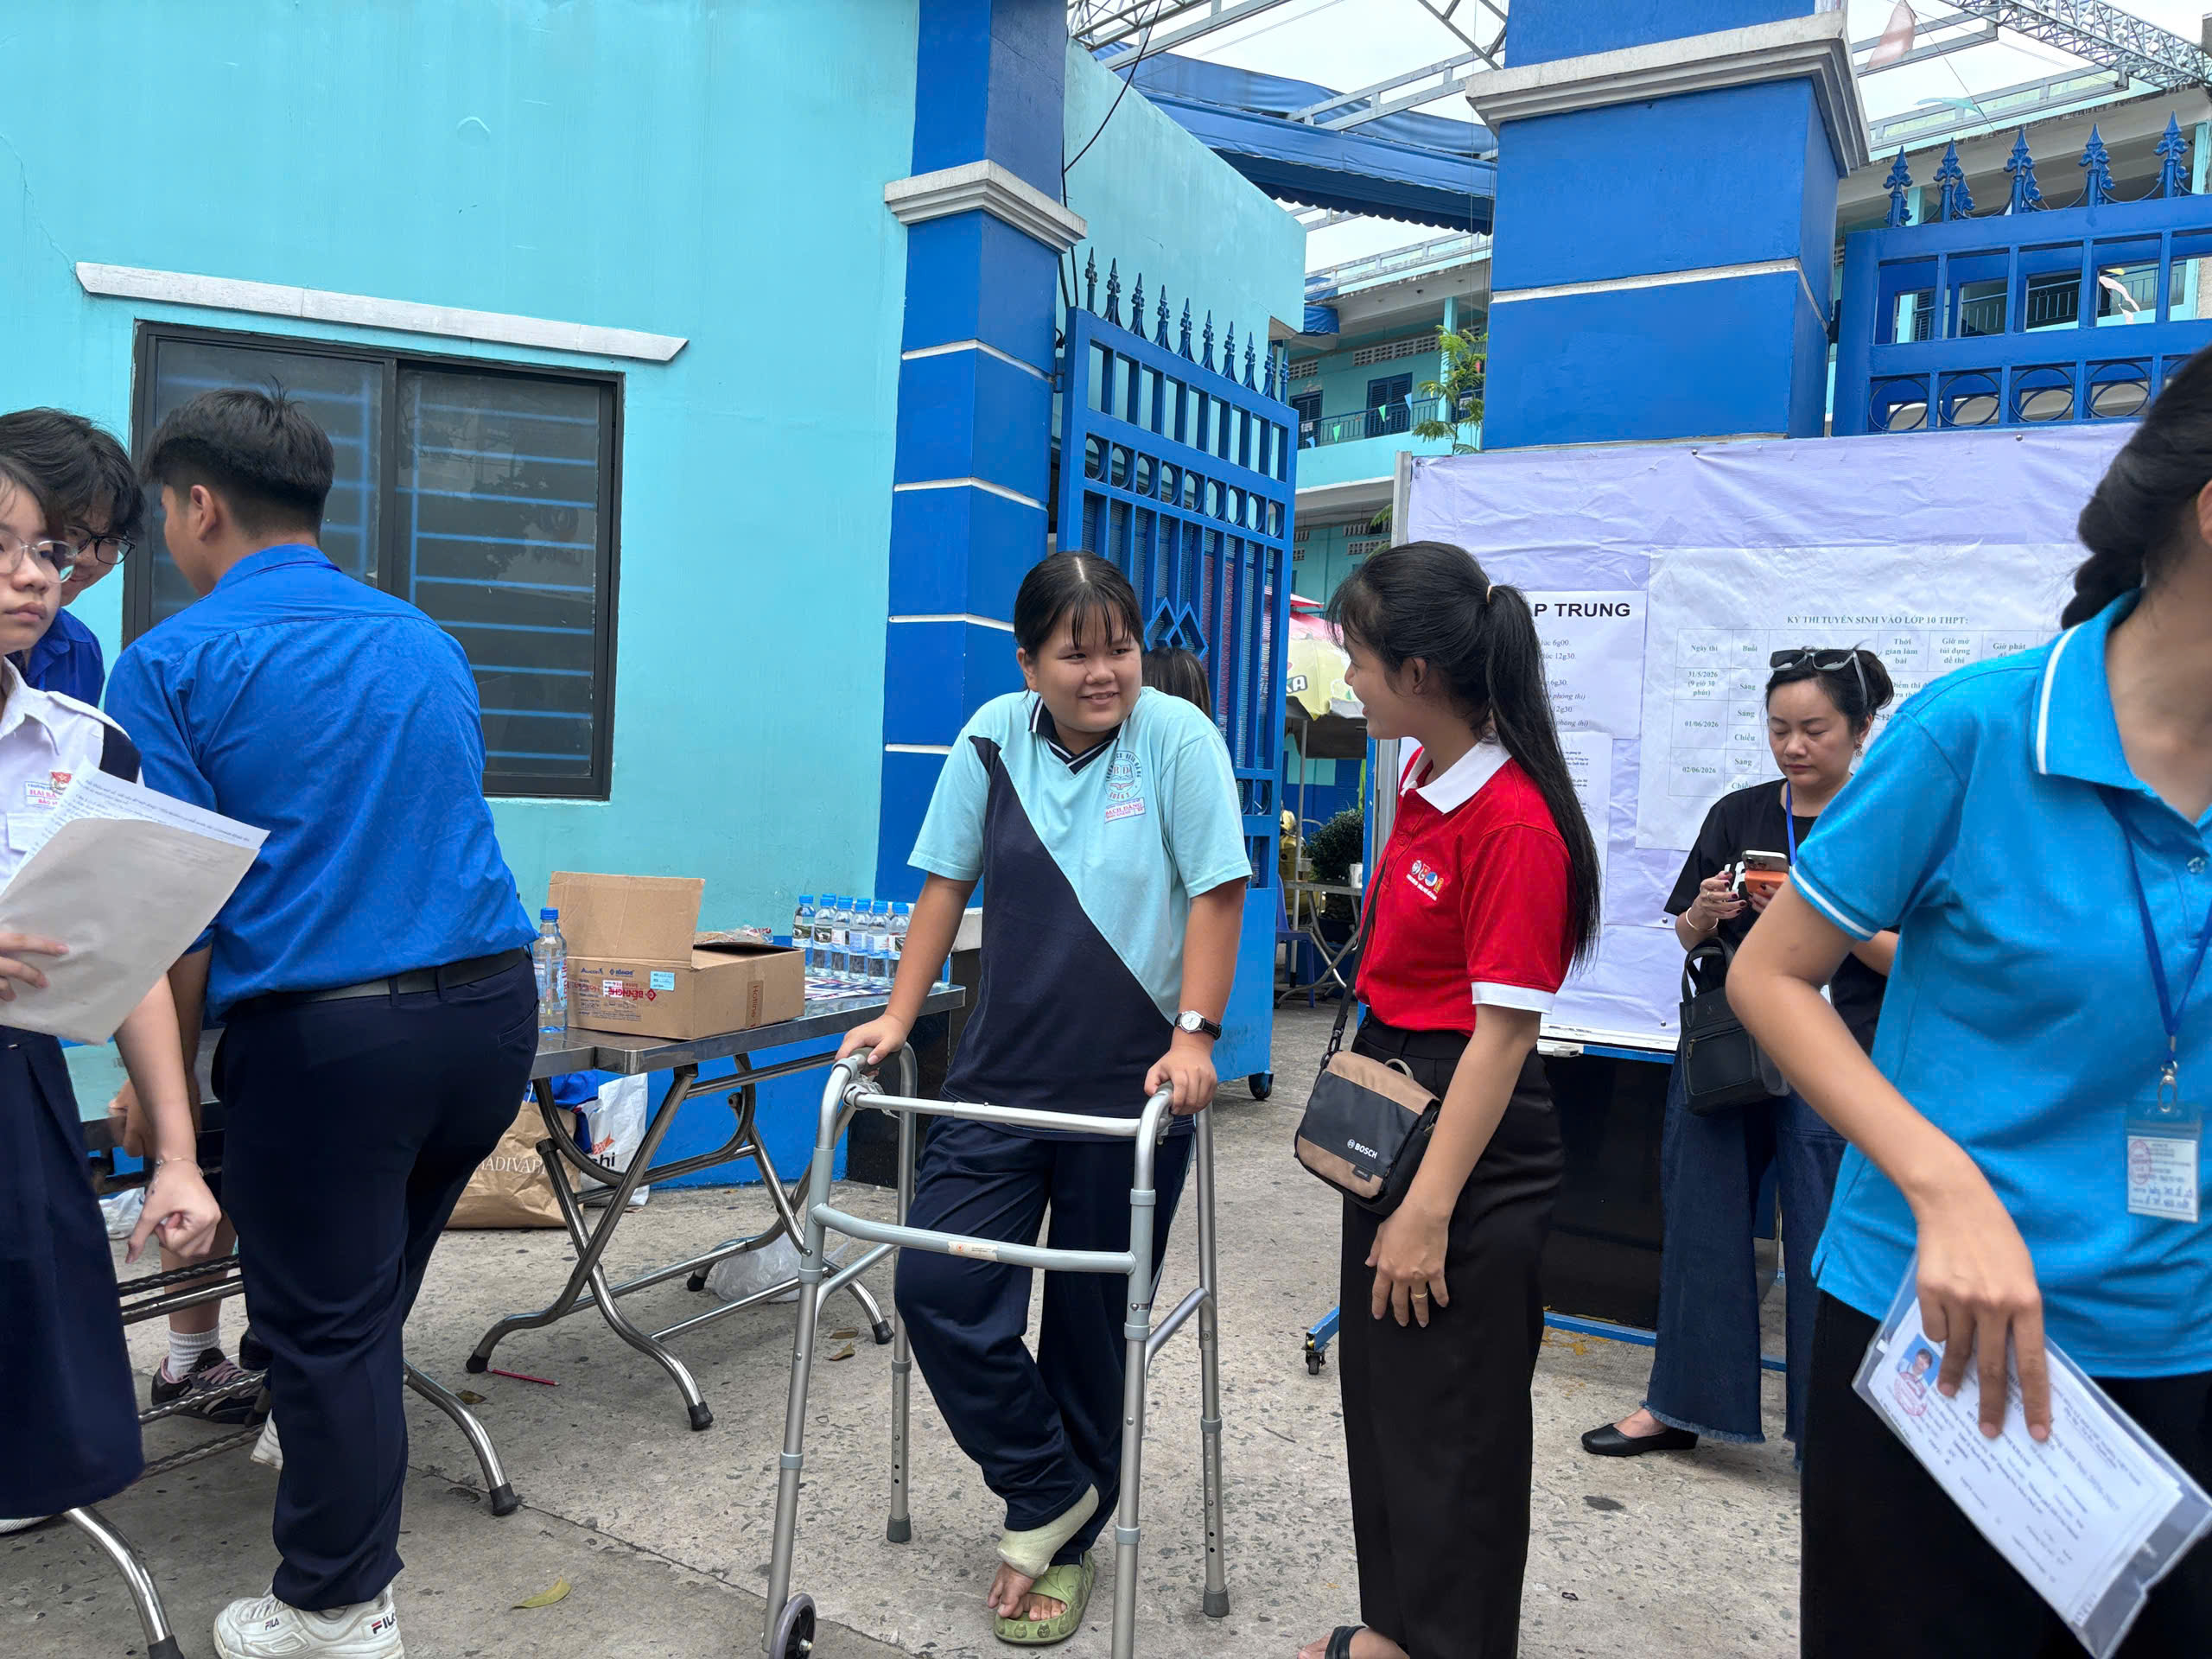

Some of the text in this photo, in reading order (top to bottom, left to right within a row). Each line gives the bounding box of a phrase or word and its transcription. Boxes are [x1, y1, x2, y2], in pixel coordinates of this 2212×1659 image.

[1554, 603, 1630, 617] TRUNG
[1354, 1142, 1378, 1159] BOSCH
[264, 1617, 280, 1631] FILA
